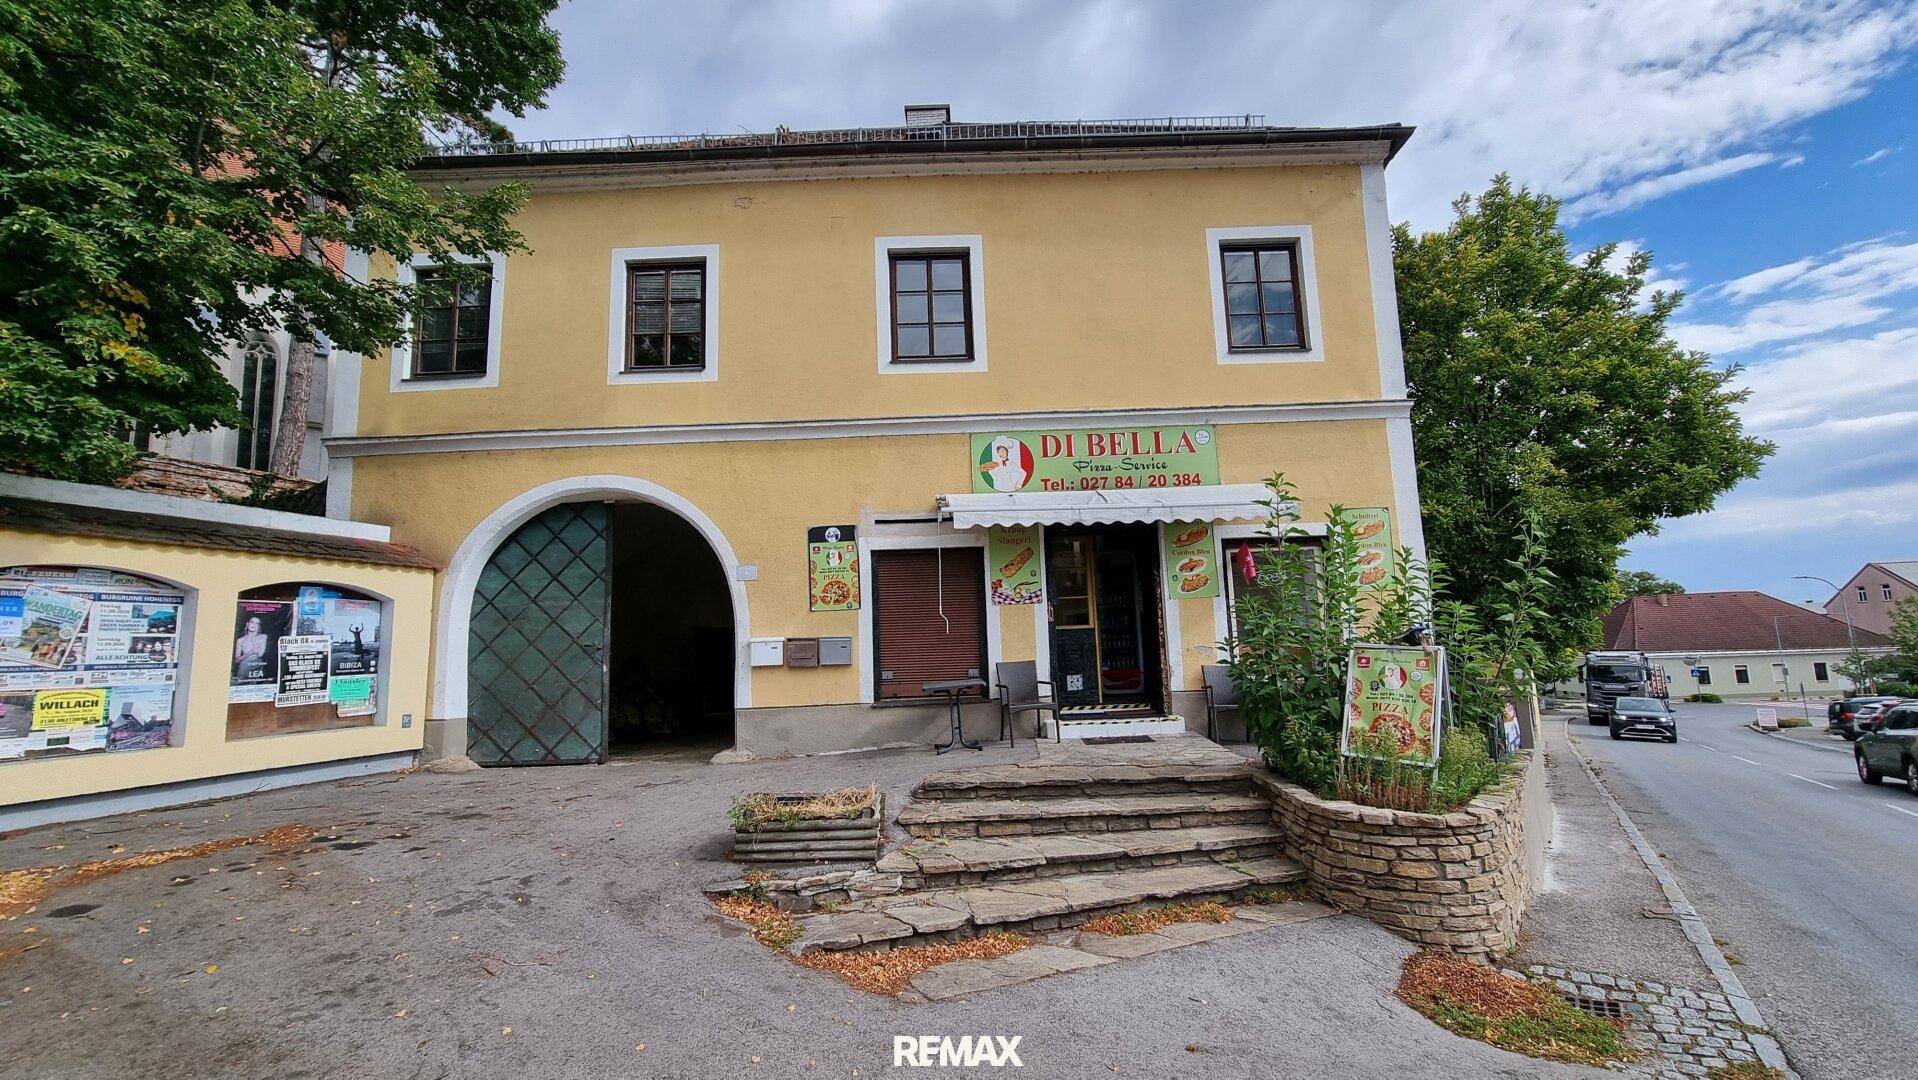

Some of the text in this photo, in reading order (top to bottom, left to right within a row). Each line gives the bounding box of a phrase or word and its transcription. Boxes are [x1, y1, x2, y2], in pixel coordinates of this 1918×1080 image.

[1039, 430, 1199, 459] DI BELLA
[1041, 478, 1075, 491] Tel.:
[1080, 476, 1108, 490] 027
[1114, 475, 1134, 488] 84
[1148, 474, 1167, 487] 20
[1172, 473, 1202, 487] 384
[101, 594, 143, 602] BURGRUINE
[280, 637, 299, 645] Black
[248, 670, 264, 678] LEA
[40, 699, 99, 710] WILLACH
[1371, 702, 1409, 715] PIZZA
